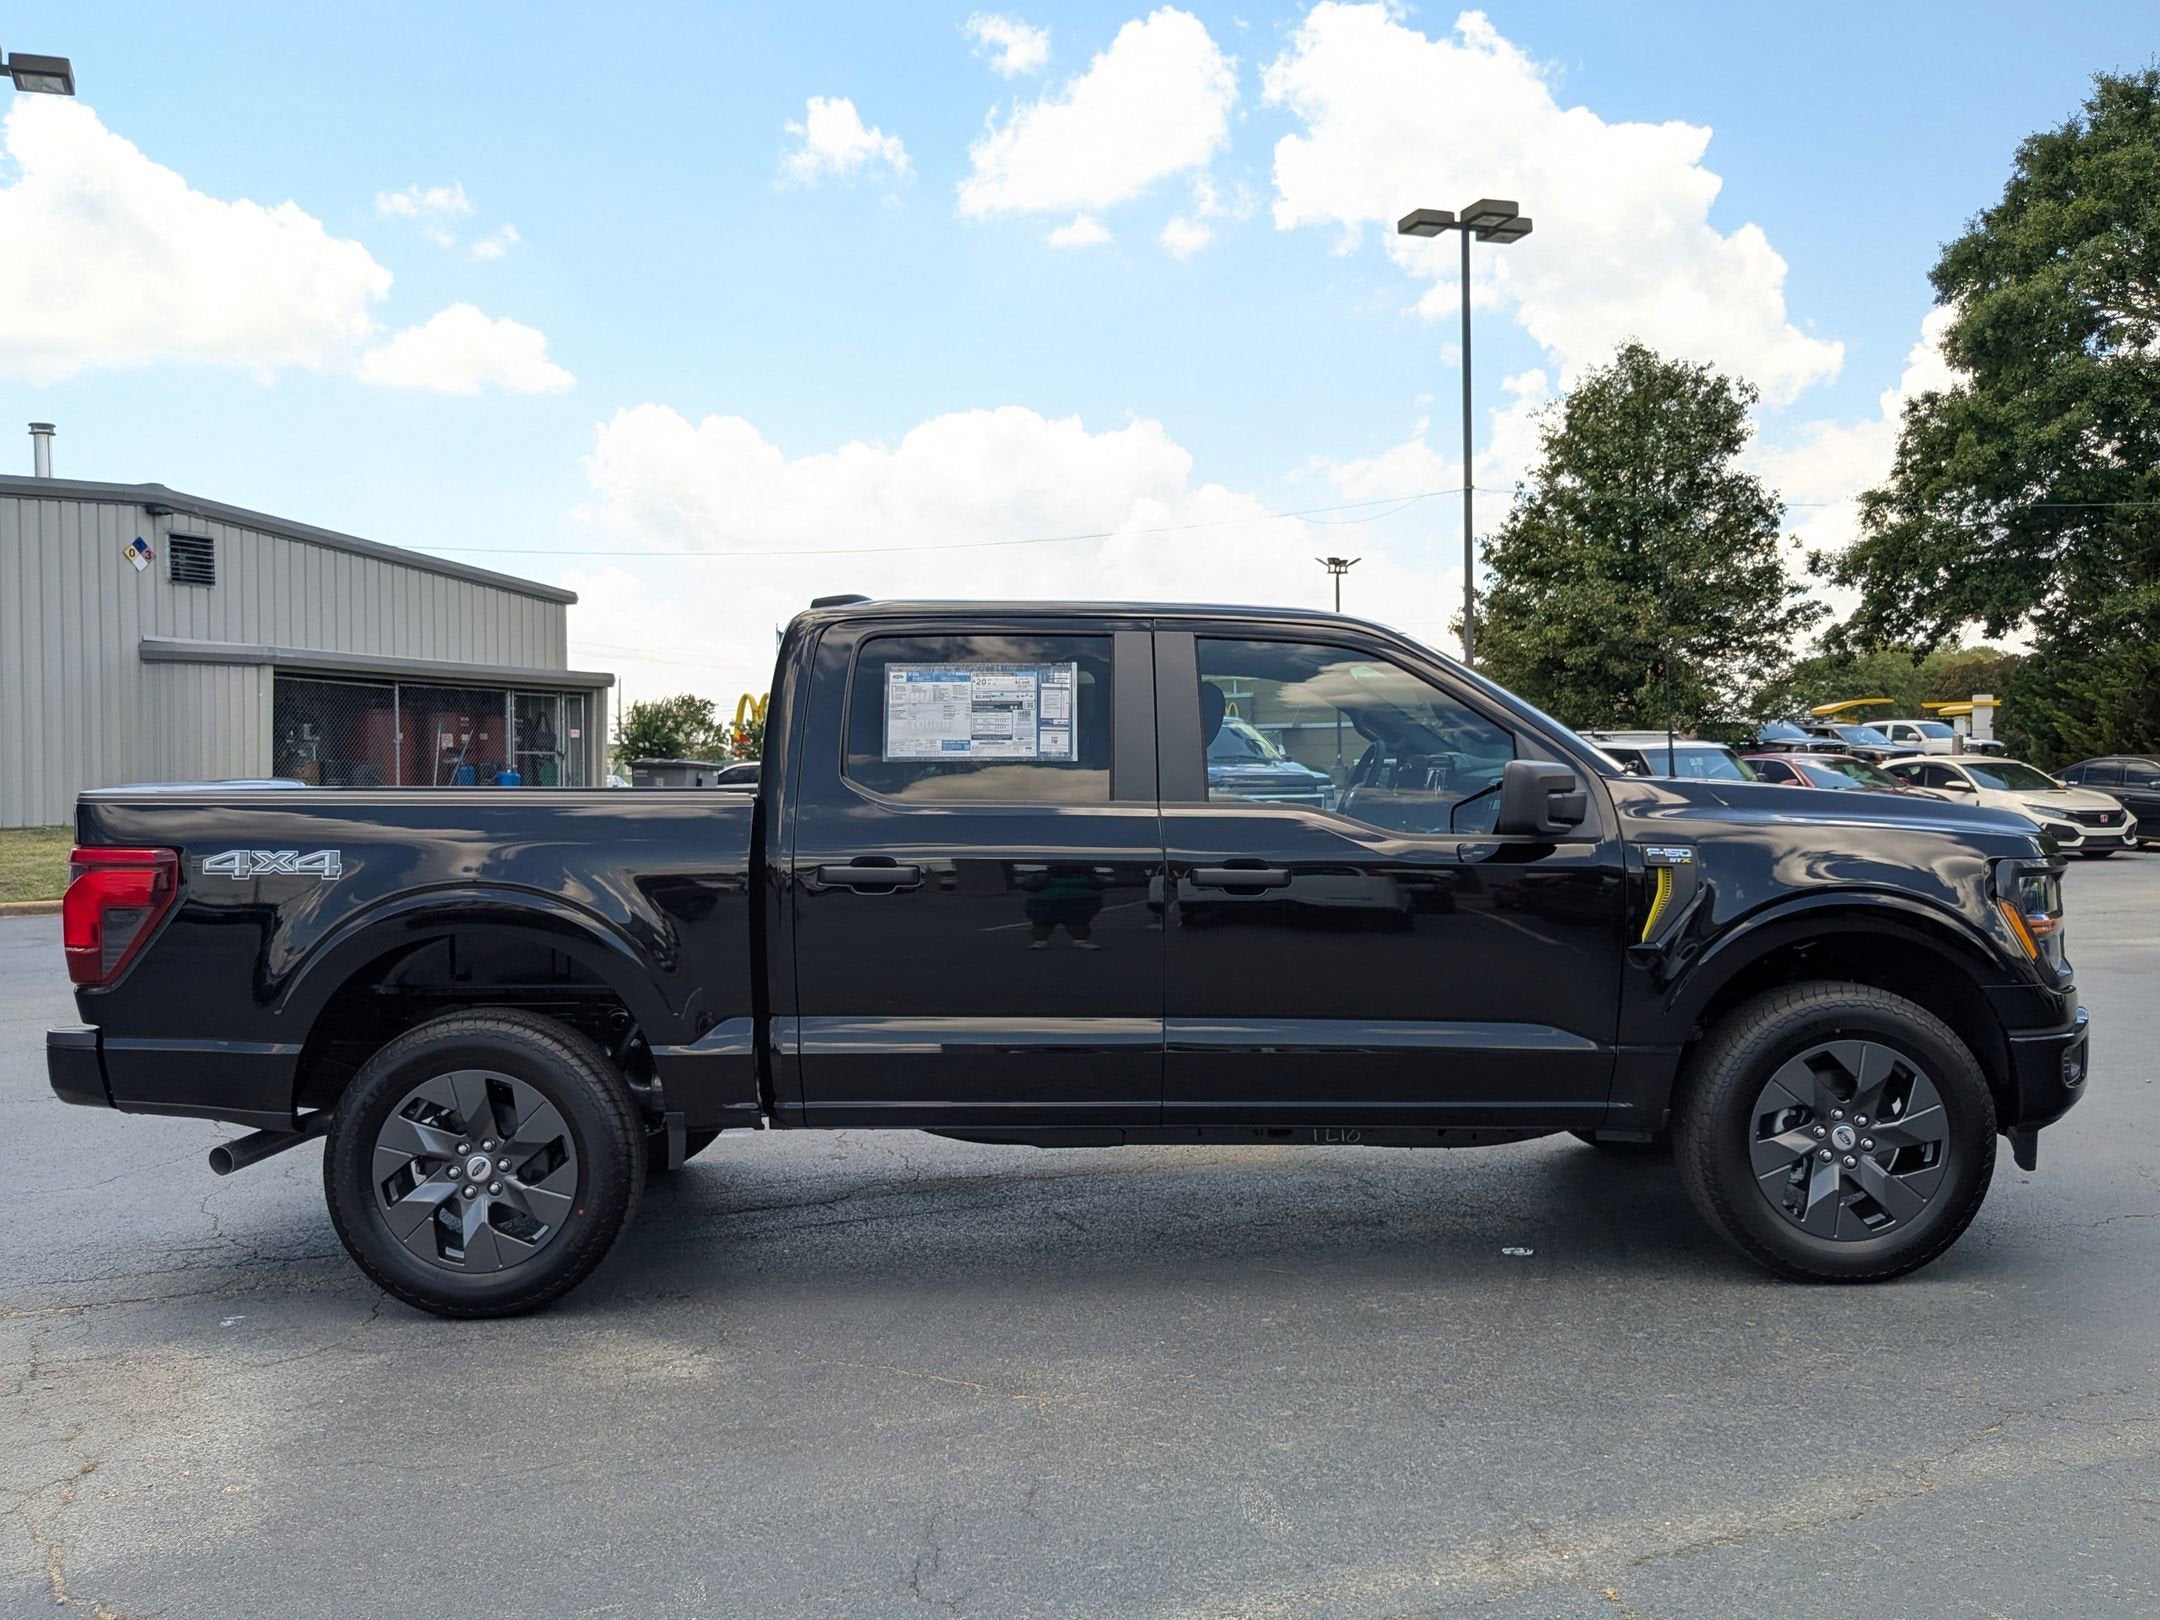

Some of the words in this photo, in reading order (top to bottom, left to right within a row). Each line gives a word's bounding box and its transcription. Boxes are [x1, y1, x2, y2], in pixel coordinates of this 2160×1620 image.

[128, 548, 136, 558] 0
[144, 550, 152, 560] 3
[976, 678, 987, 686] 20
[1646, 847, 1693, 857] F-150
